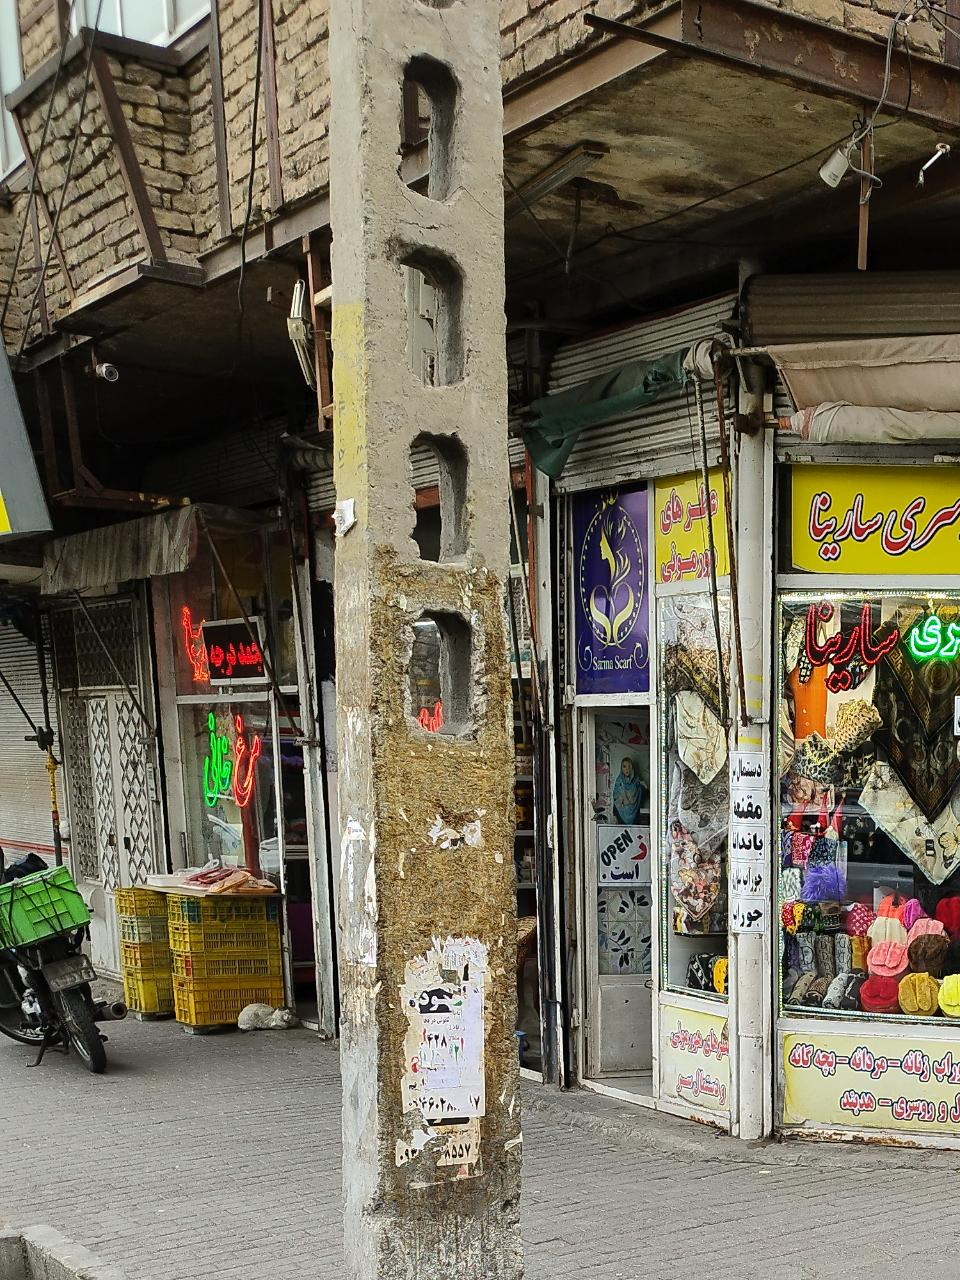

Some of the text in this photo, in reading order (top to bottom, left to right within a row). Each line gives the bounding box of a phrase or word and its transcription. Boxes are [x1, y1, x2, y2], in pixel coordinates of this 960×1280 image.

[660, 488, 683, 535] های
[809, 491, 883, 560] سارینا
[803, 602, 900, 693] سارینا
[592, 654, 634, 671] Sarina Scarf
[737, 757, 762, 782] دستمال
[601, 829, 634, 867] OPEN
[732, 903, 763, 928] جوراب
[813, 1048, 835, 1076] بچه
[849, 1046, 888, 1079] مردانه
[902, 1049, 931, 1082] زنانه
[840, 1089, 877, 1116] هدبند
[891, 1096, 936, 1123] روسری
[936, 1104, 948, 1122] و
